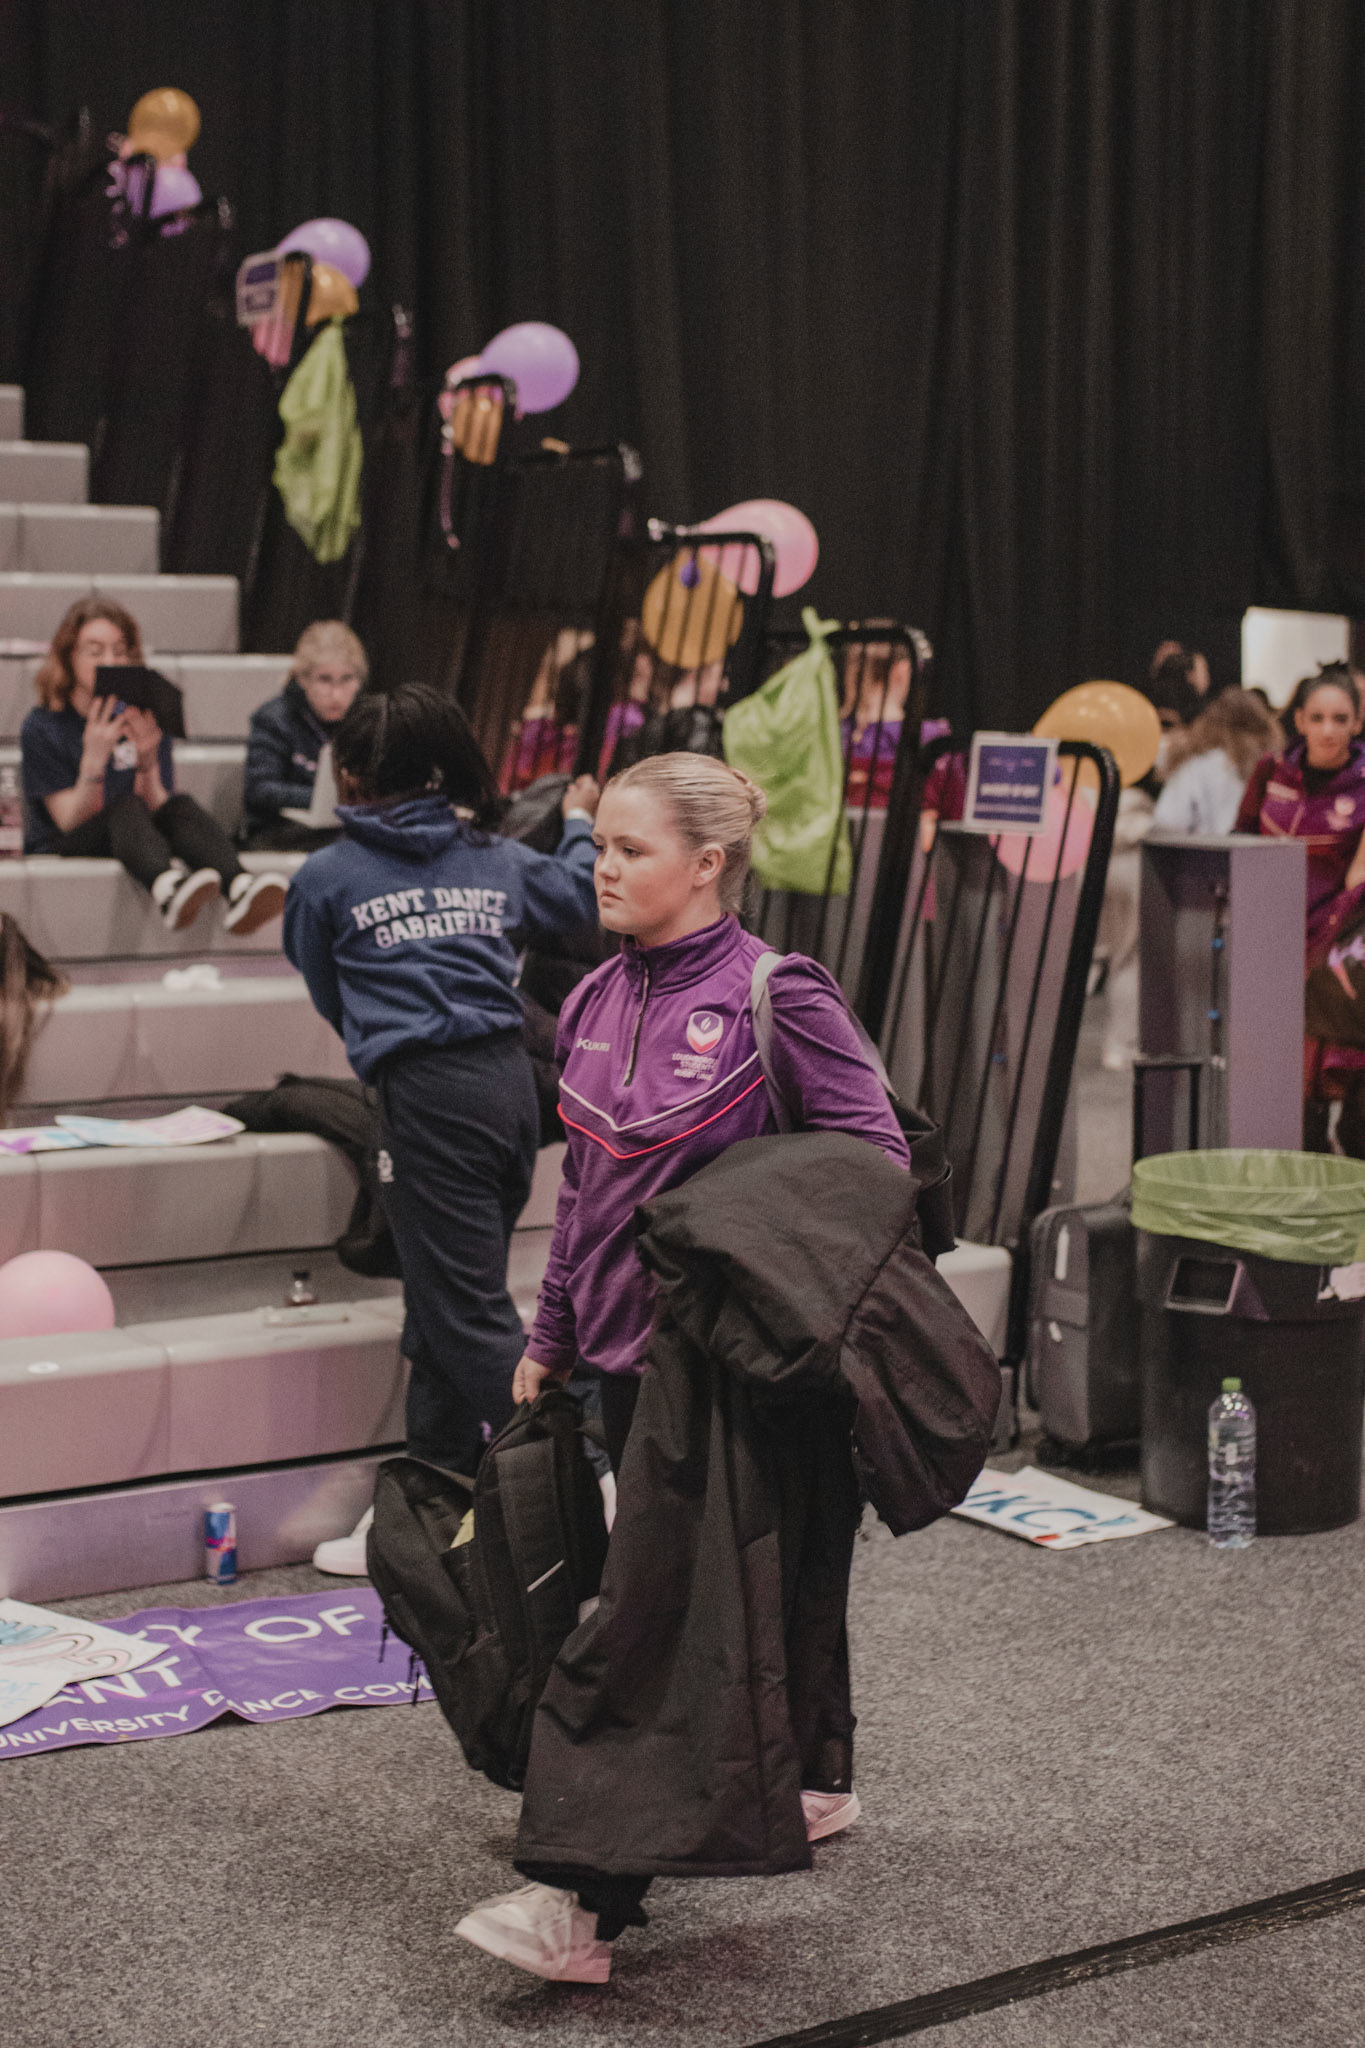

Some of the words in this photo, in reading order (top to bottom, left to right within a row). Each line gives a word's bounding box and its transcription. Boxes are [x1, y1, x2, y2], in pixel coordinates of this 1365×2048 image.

[351, 888, 426, 931] KENT
[432, 887, 508, 916] DANCE
[375, 910, 503, 949] GABRIELLE
[243, 1605, 366, 1643] OF
